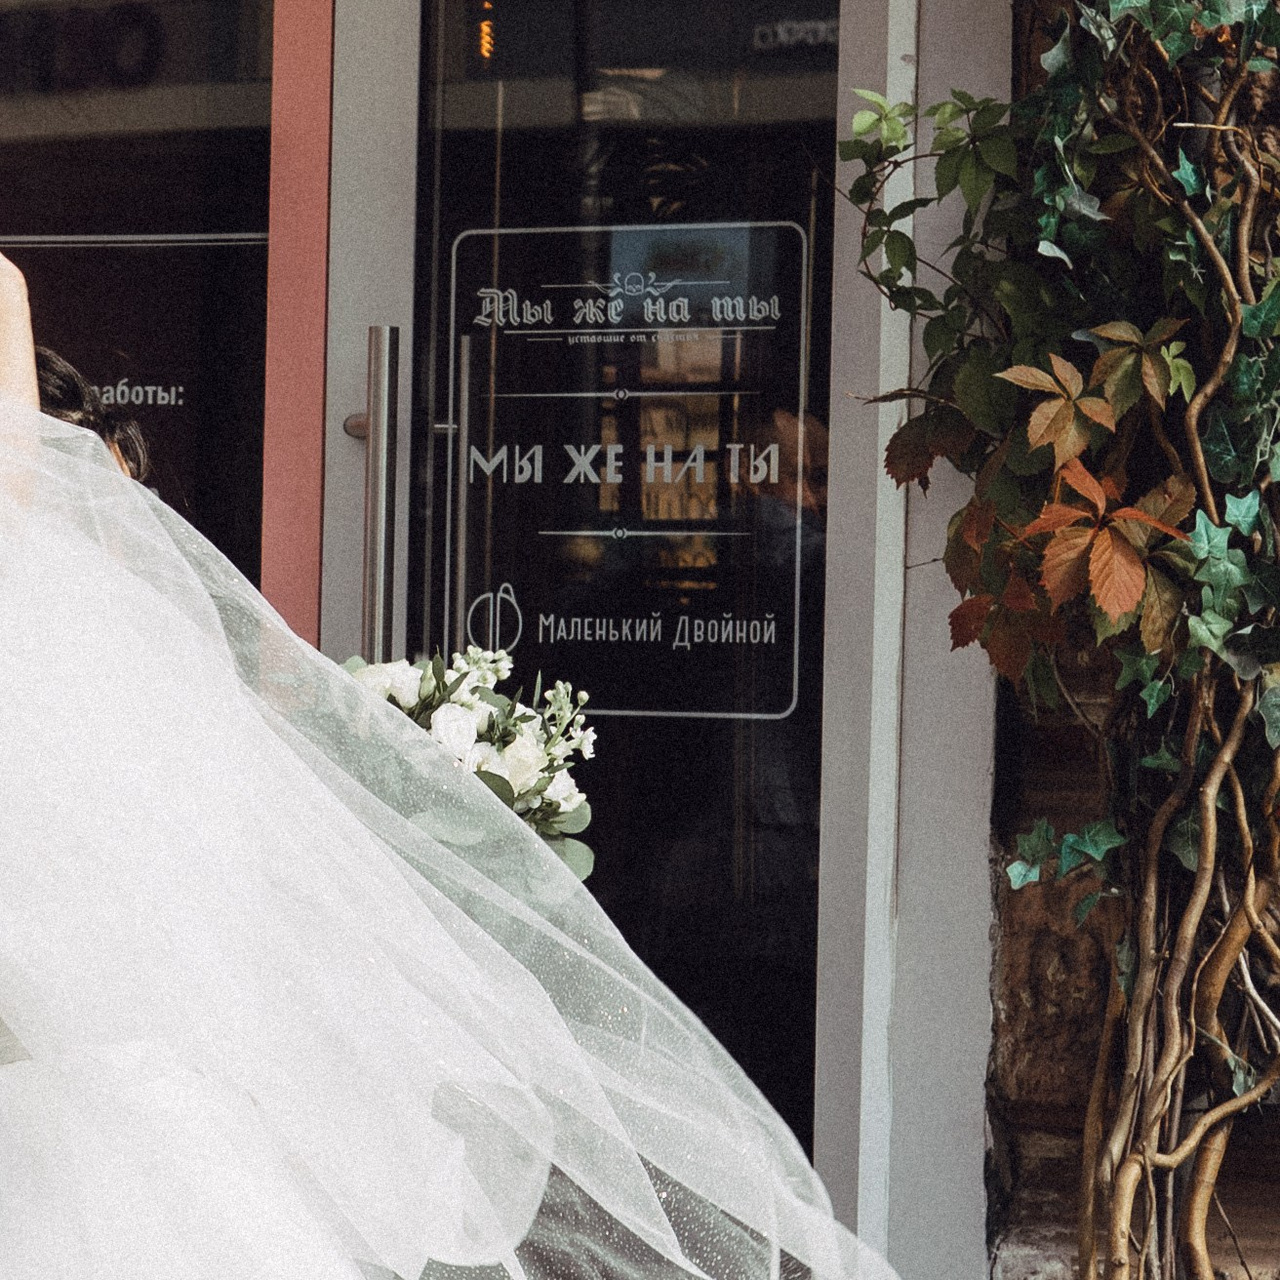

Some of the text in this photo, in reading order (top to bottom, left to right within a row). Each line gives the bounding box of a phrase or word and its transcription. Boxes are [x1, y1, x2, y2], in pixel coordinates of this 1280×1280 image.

[473, 288, 781, 326] Мы же на ты
[470, 443, 779, 484] МЫ ЖЕ НА ТЫ
